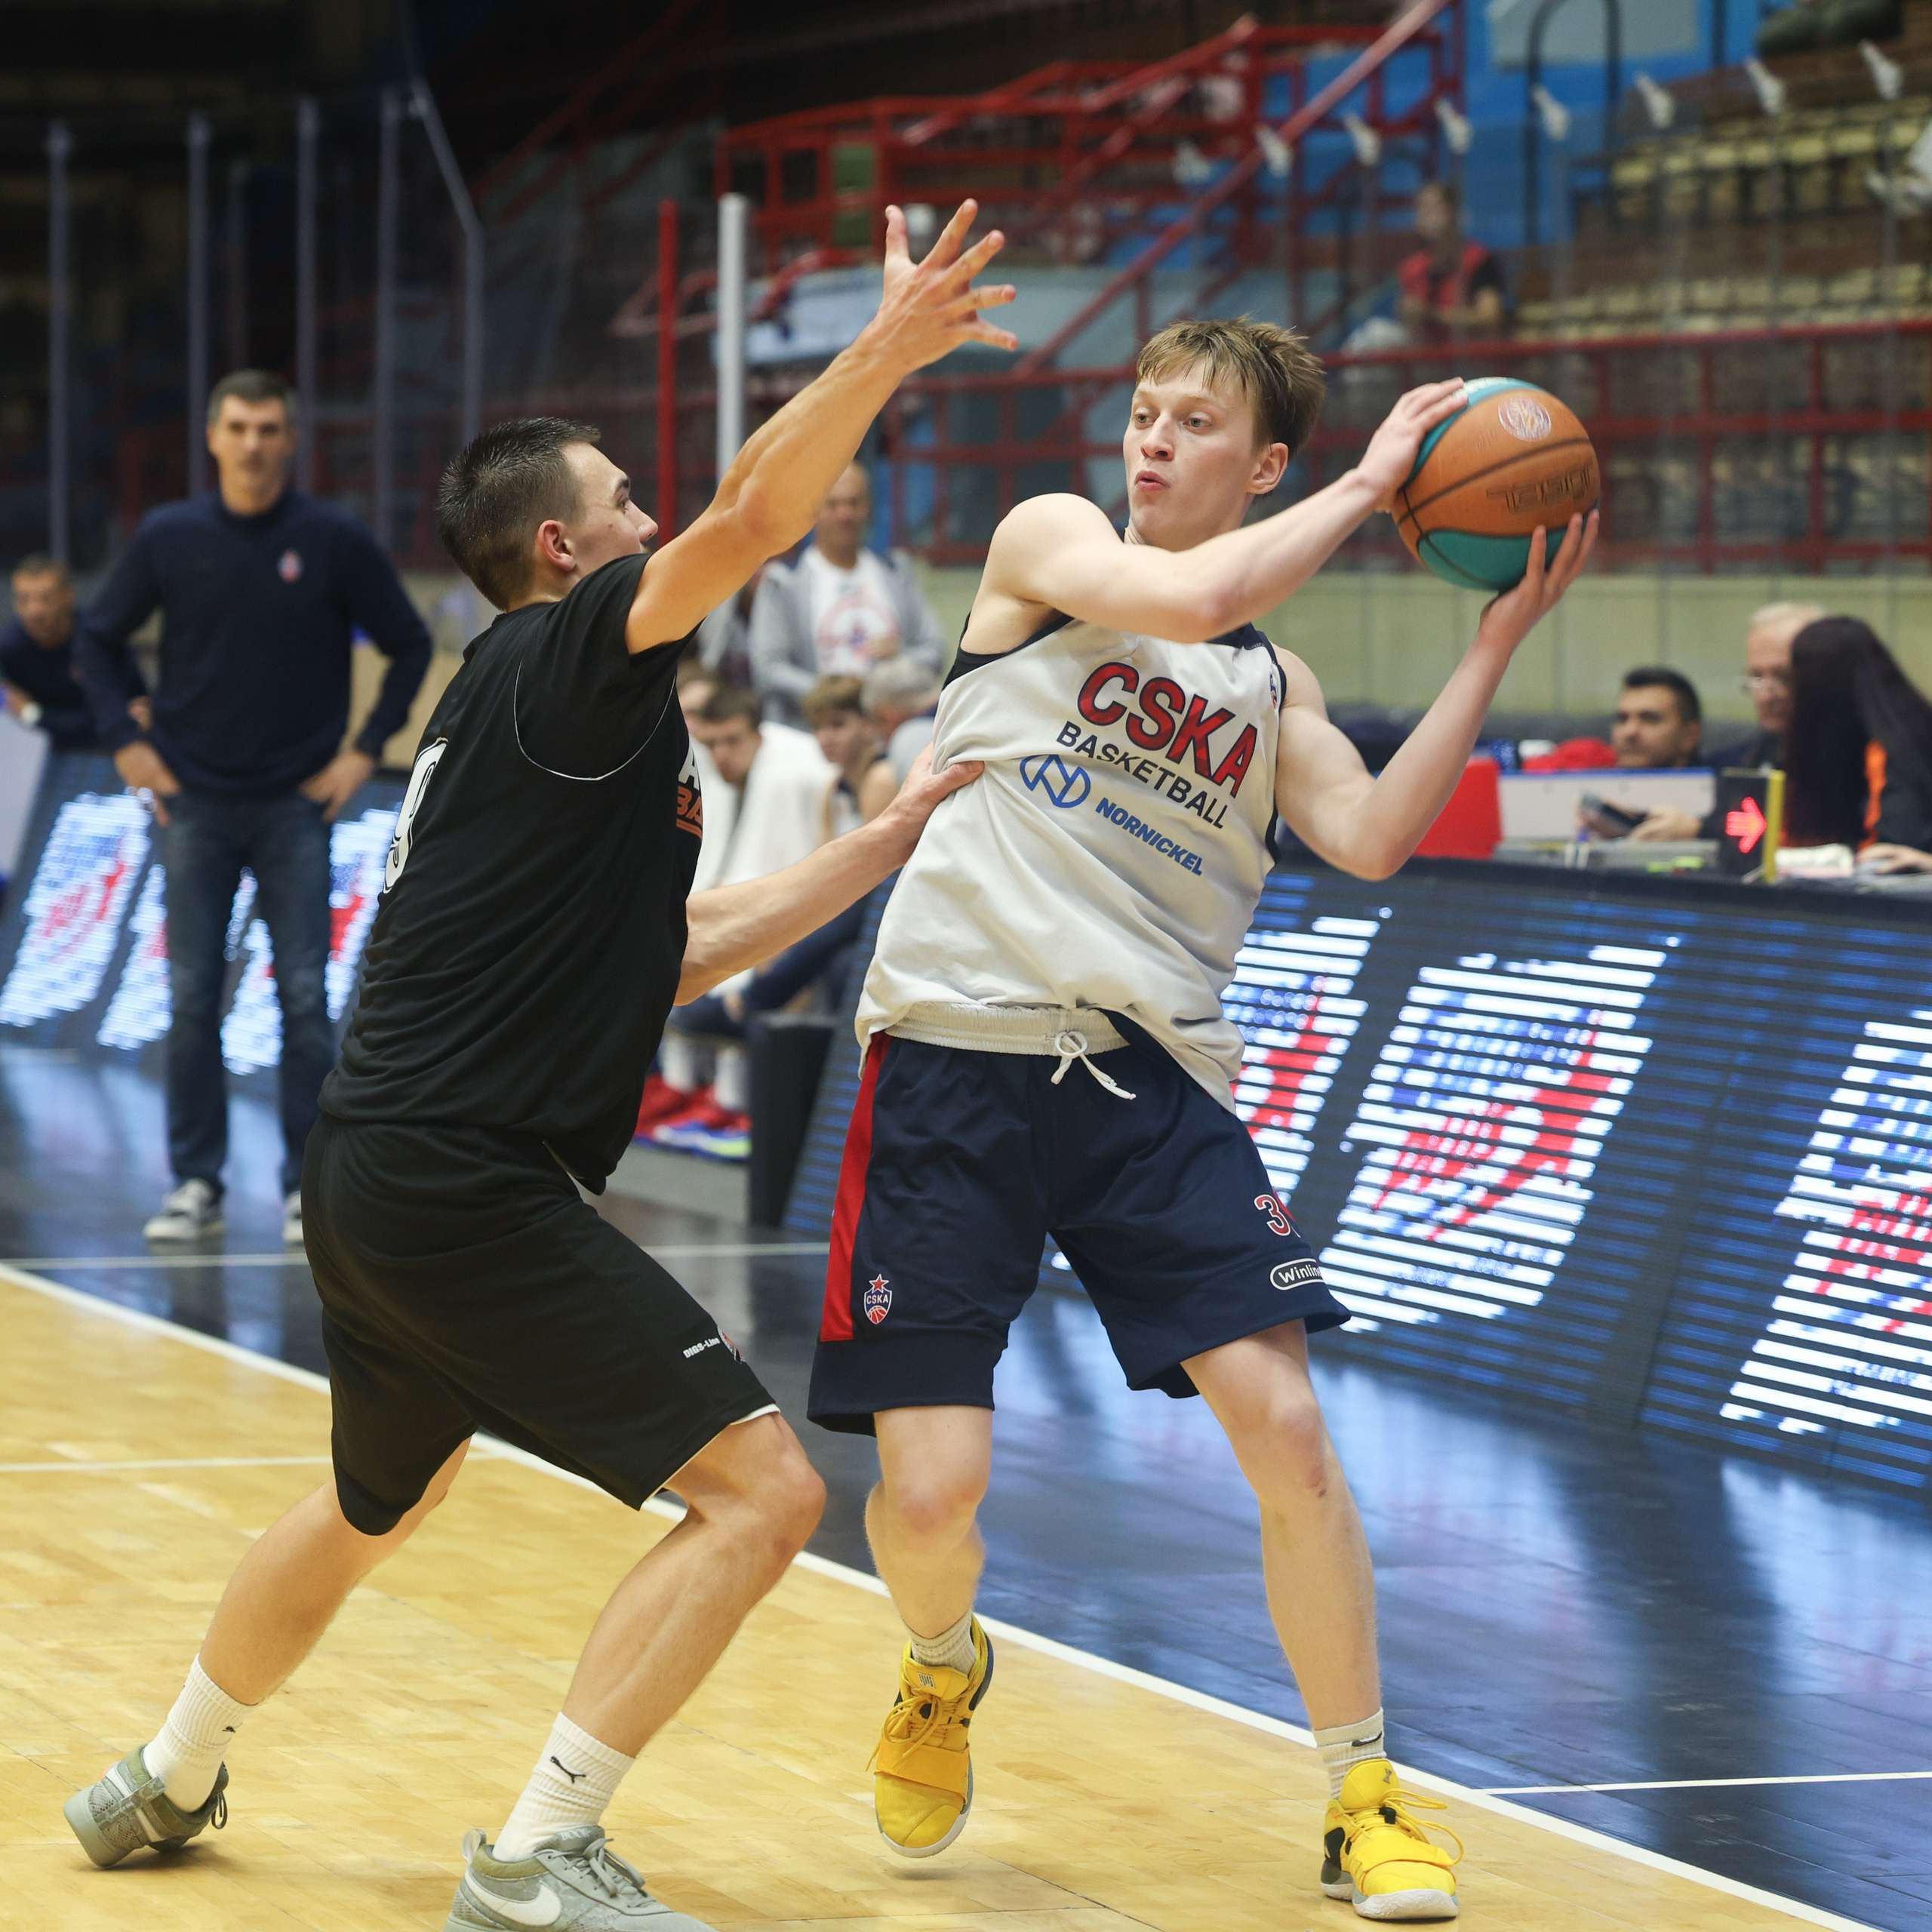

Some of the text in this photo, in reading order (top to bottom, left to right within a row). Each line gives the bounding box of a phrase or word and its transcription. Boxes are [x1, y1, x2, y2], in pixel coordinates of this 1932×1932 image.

[1077, 662, 1258, 798] CSKA
[1056, 721, 1228, 829] BASKETBALL
[1095, 798, 1203, 876] NORNICKEL
[1254, 1194, 1301, 1238] 3
[866, 1294, 889, 1304] CSKA
[560, 1828, 592, 1841] BOOK
